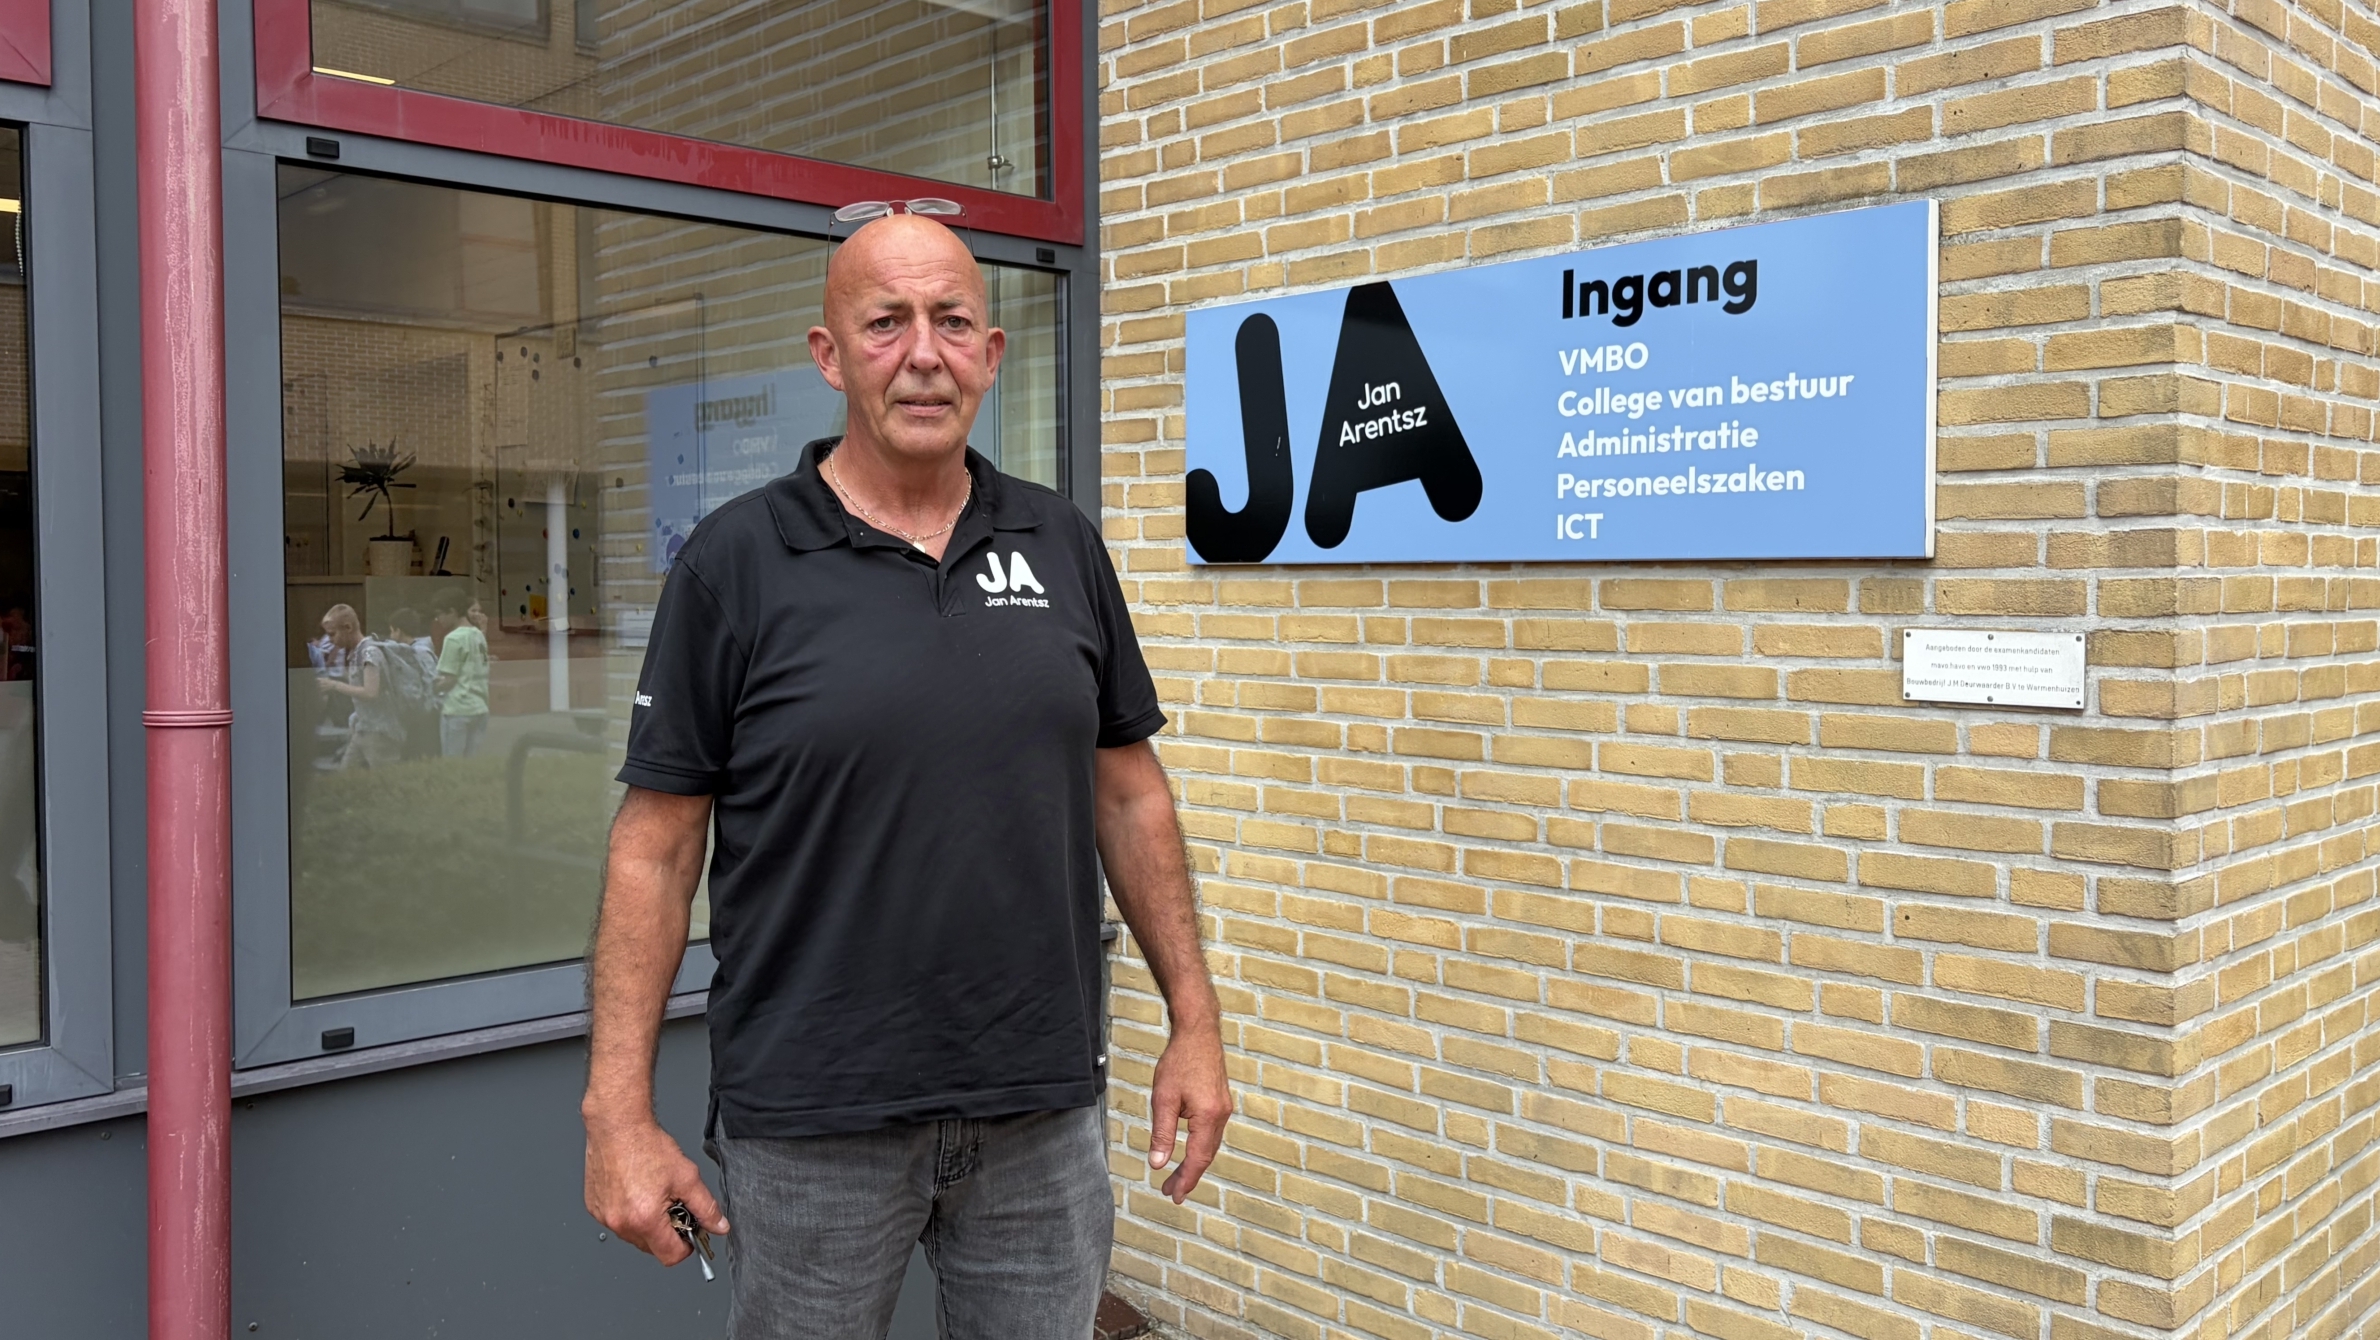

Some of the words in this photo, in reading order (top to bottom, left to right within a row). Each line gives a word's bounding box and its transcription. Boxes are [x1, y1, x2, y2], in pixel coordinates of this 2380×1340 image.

[1562, 259, 1758, 328] Ingang
[1558, 342, 1649, 376] VMBO
[1357, 382, 1401, 410] Jan
[1557, 387, 1663, 420] College
[1668, 382, 1723, 409] van
[1731, 372, 1855, 405] bestuur
[1186, 281, 1484, 563] JA
[1339, 406, 1428, 447] Arentsz
[1557, 420, 1759, 458] Administratie
[1557, 463, 1805, 499] Personeelszaken
[1557, 513, 1604, 540] ICT
[976, 551, 1045, 594] JA
[985, 596, 1008, 607] Jan
[1010, 595, 1050, 608] Arentsz
[1925, 643, 1966, 653] Aangeboden
[1967, 645, 1982, 653] door
[1994, 647, 2060, 656] examenkandidaten
[1992, 663, 2007, 672] 1993
[2023, 665, 2039, 674] hulp
